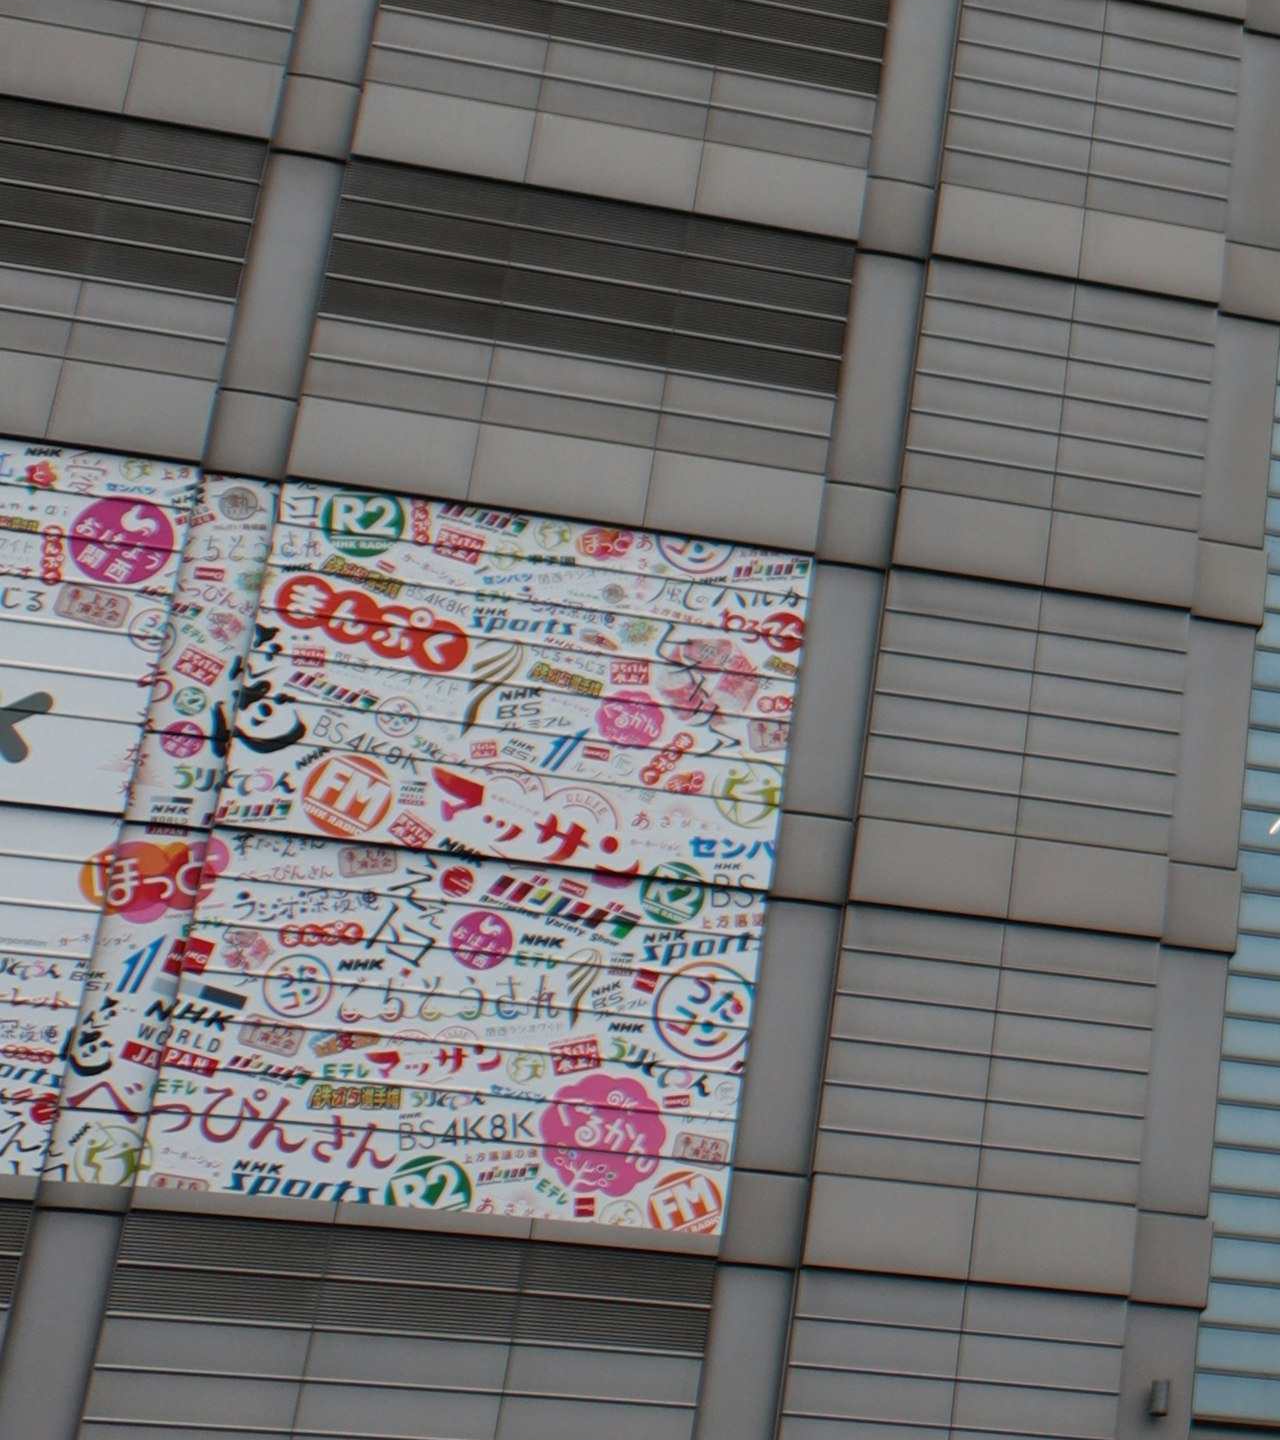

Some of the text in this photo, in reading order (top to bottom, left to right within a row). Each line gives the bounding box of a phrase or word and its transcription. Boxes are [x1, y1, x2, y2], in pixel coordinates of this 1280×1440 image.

[332, 493, 397, 535] R2
[288, 582, 458, 666] まんぷく
[473, 606, 508, 617] NHK
[468, 616, 576, 636] sports
[499, 689, 542, 701] NHK
[497, 702, 542, 719] BS
[295, 747, 331, 770] NHK
[311, 758, 391, 815] FM
[92, 850, 220, 907] ほっと
[521, 934, 565, 949] NHK
[544, 917, 586, 937] Variety
[589, 934, 619, 947] Show
[643, 930, 686, 944] NHK
[337, 958, 385, 971] NHK
[592, 981, 621, 997] NHK
[145, 998, 235, 1032] NHK
[608, 1023, 644, 1034] NHK
[138, 1023, 221, 1053] WORLD
[132, 1046, 211, 1073] JAPAN
[322, 1063, 369, 1078] Eテレ
[66, 1081, 398, 1170] べっぴんさん
[399, 1111, 535, 1152] BS4K8K
[557, 1099, 655, 1173] ぐるかん
[234, 1160, 284, 1174] NHK
[223, 1173, 379, 1204] sports
[652, 1176, 719, 1230] FM
